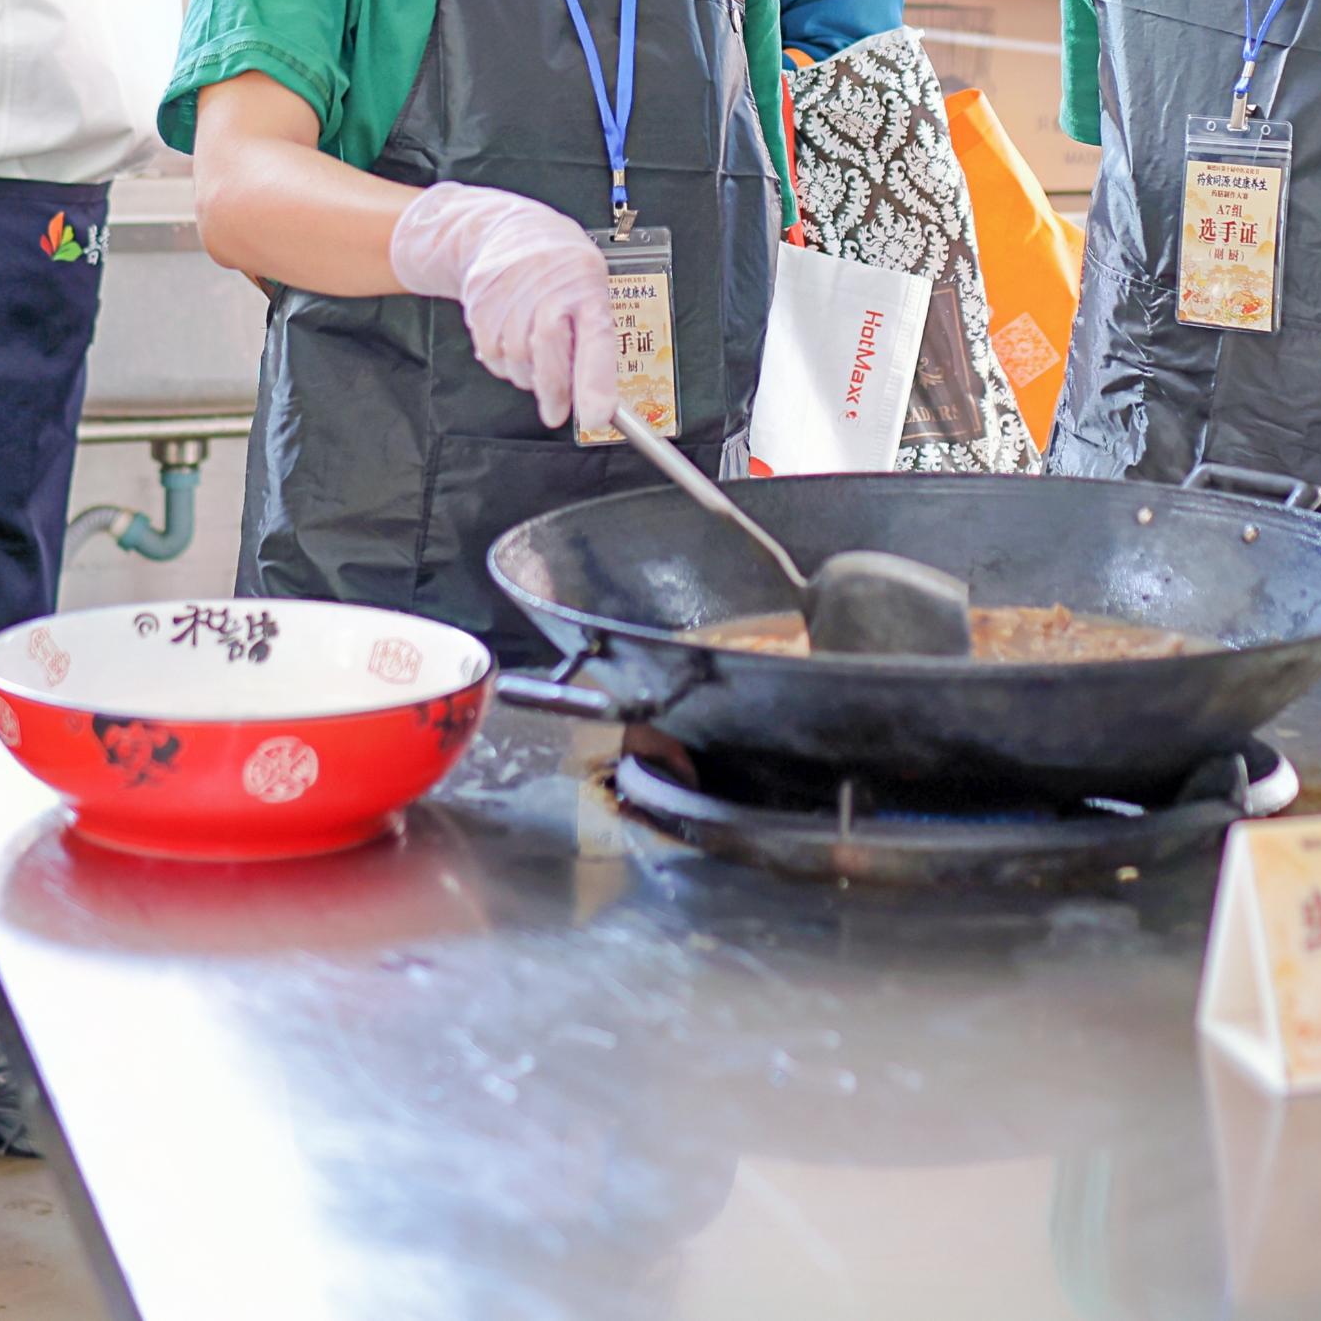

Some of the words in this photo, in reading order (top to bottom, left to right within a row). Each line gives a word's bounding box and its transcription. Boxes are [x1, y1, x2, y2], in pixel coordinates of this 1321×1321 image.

[1216, 204, 1243, 218] A7组
[1198, 217, 1258, 245] 选手证
[616, 330, 655, 355] 手证
